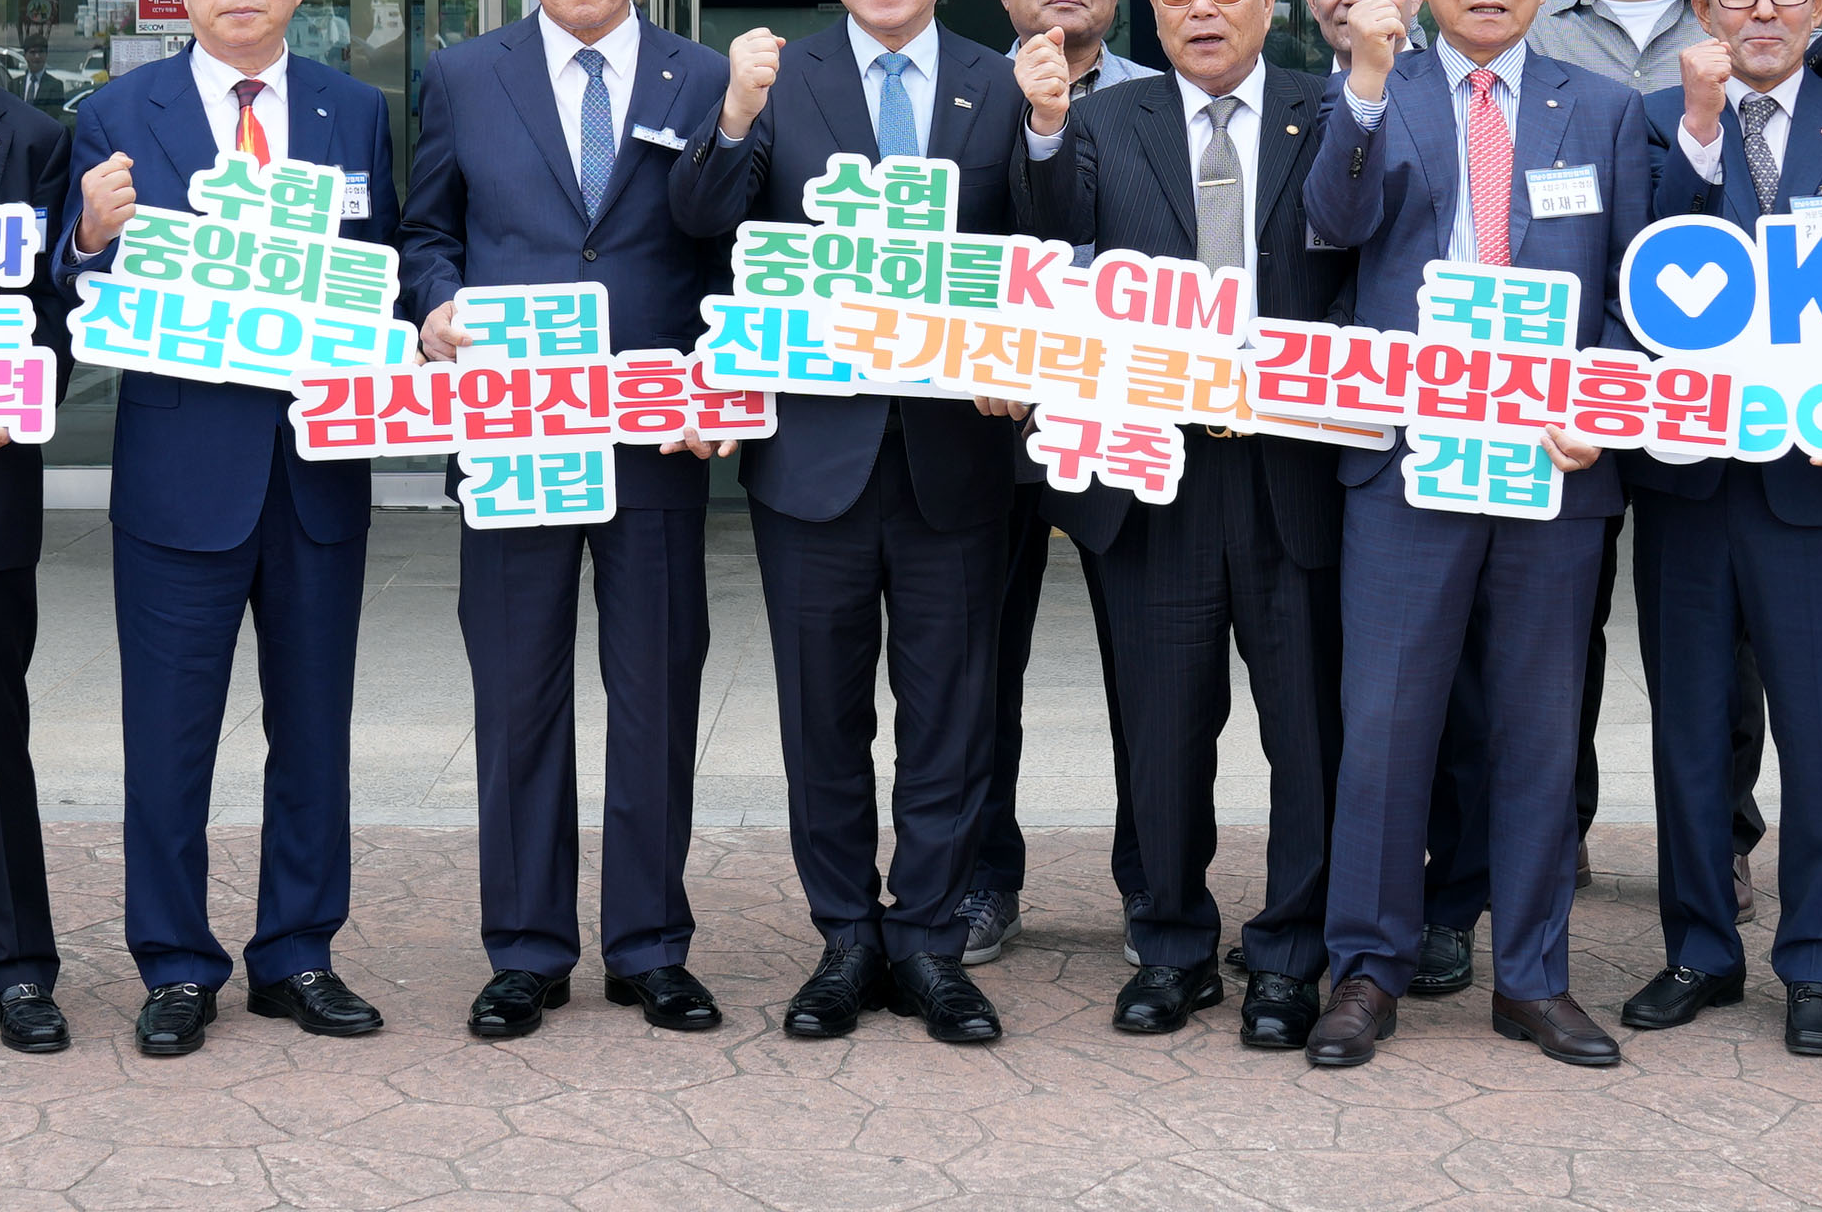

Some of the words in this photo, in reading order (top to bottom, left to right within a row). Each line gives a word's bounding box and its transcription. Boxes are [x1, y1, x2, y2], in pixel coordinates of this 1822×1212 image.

[200, 158, 335, 235] 수협
[815, 162, 948, 232] 수협
[123, 213, 389, 315] 중앙회를
[743, 229, 1004, 309] 중앙회를
[1006, 246, 1240, 336] K-GIM
[464, 292, 600, 359] 국립
[1428, 272, 1571, 347] 국립
[301, 359, 767, 449] 김산업진흥원
[833, 301, 1108, 401] 국가전략
[1126, 343, 1384, 439] 클러
[1254, 328, 1734, 447] 김산업진흥원
[469, 449, 606, 519] 건립
[1038, 414, 1172, 492] 구축
[1413, 433, 1554, 509] 건립
